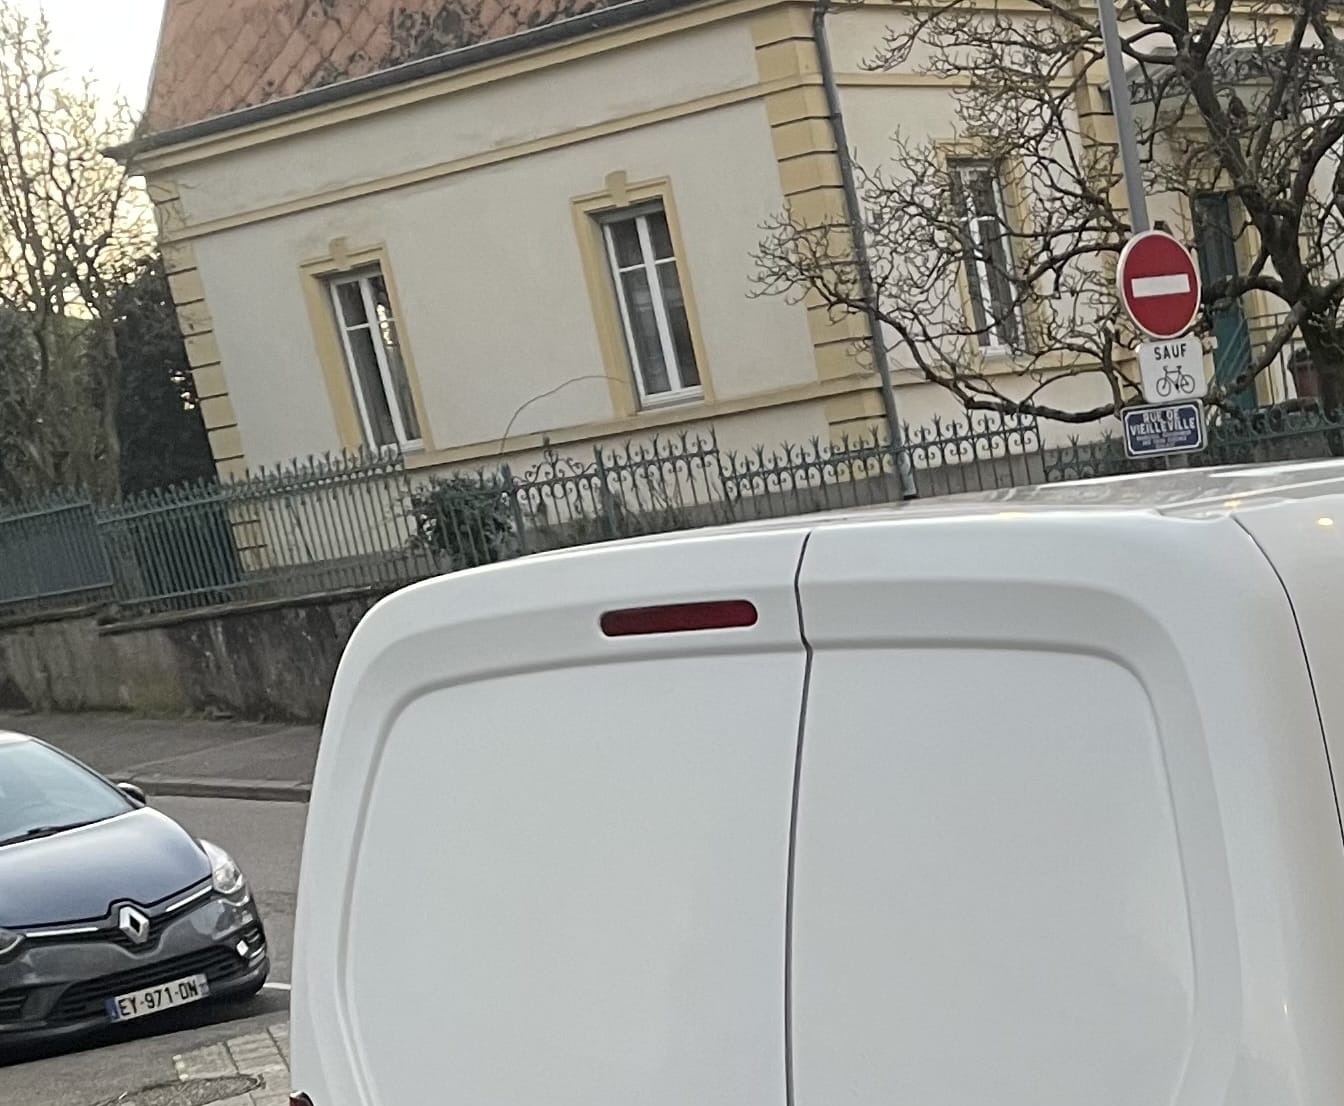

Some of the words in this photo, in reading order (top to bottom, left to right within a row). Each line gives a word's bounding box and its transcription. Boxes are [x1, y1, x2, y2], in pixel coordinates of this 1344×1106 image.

[1154, 343, 1187, 361] SAUF
[1142, 410, 1163, 424] RUE
[1166, 408, 1180, 422] DE
[1129, 416, 1196, 436] VIEILLEVILLE
